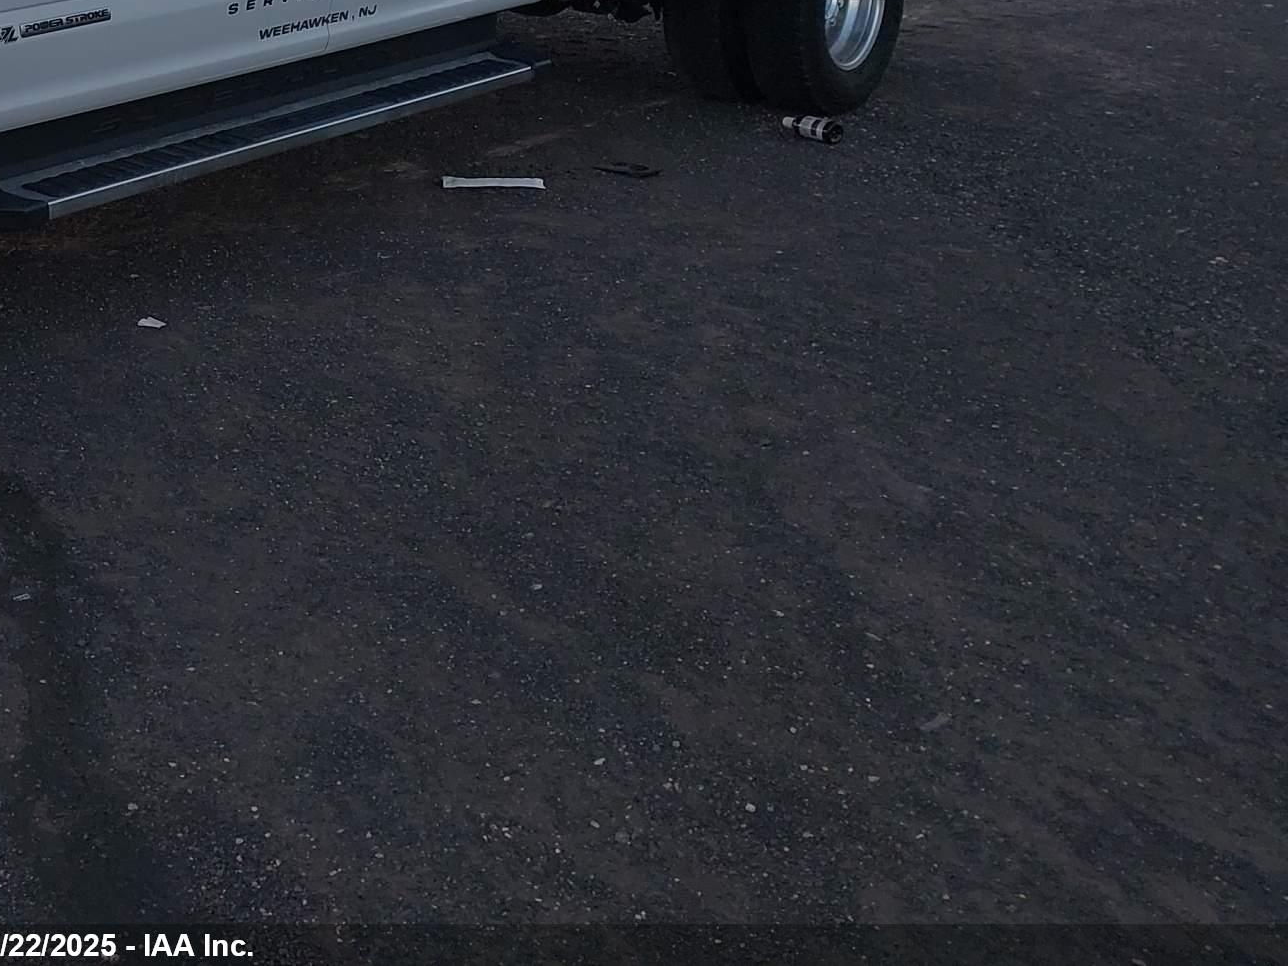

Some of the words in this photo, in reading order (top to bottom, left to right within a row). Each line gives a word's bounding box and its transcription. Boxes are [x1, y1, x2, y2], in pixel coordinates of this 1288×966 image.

[24, 18, 65, 33] POWER
[65, 8, 109, 25] STROKE
[359, 5, 378, 18] NJ
